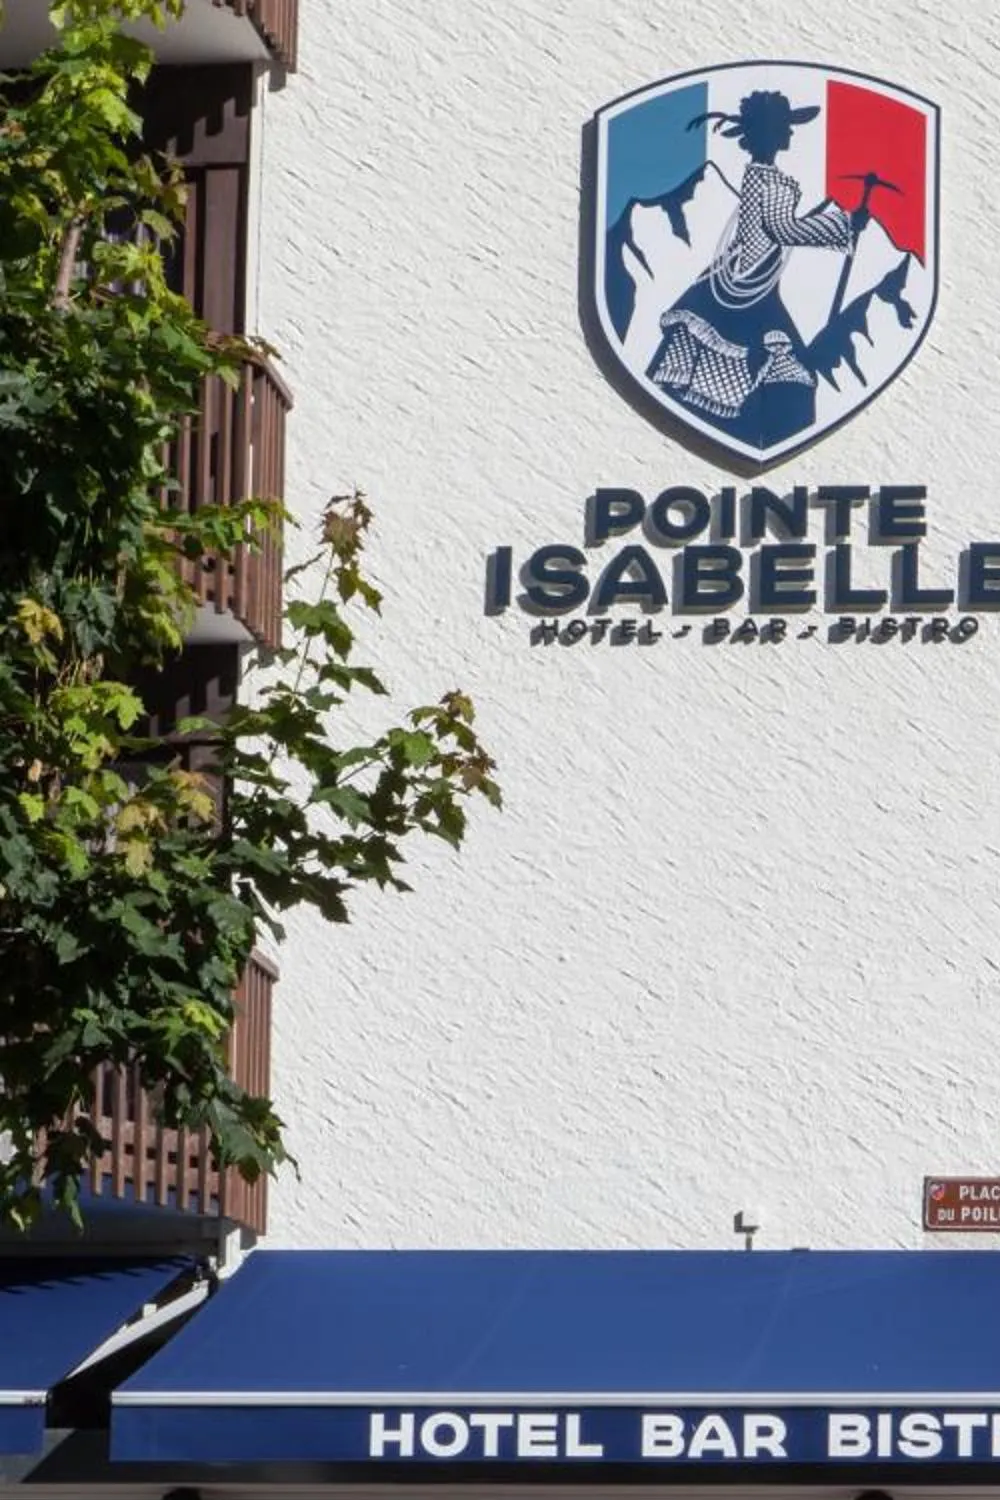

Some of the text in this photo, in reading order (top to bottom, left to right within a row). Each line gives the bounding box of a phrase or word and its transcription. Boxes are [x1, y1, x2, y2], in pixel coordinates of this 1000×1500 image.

[595, 485, 928, 539] POINTE
[539, 618, 663, 638] HOTEL
[712, 617, 788, 637] BAR
[838, 616, 979, 637] BISTRO
[937, 1208, 956, 1221] DU
[368, 1413, 604, 1459] HOTEL
[640, 1413, 788, 1459] BAR
